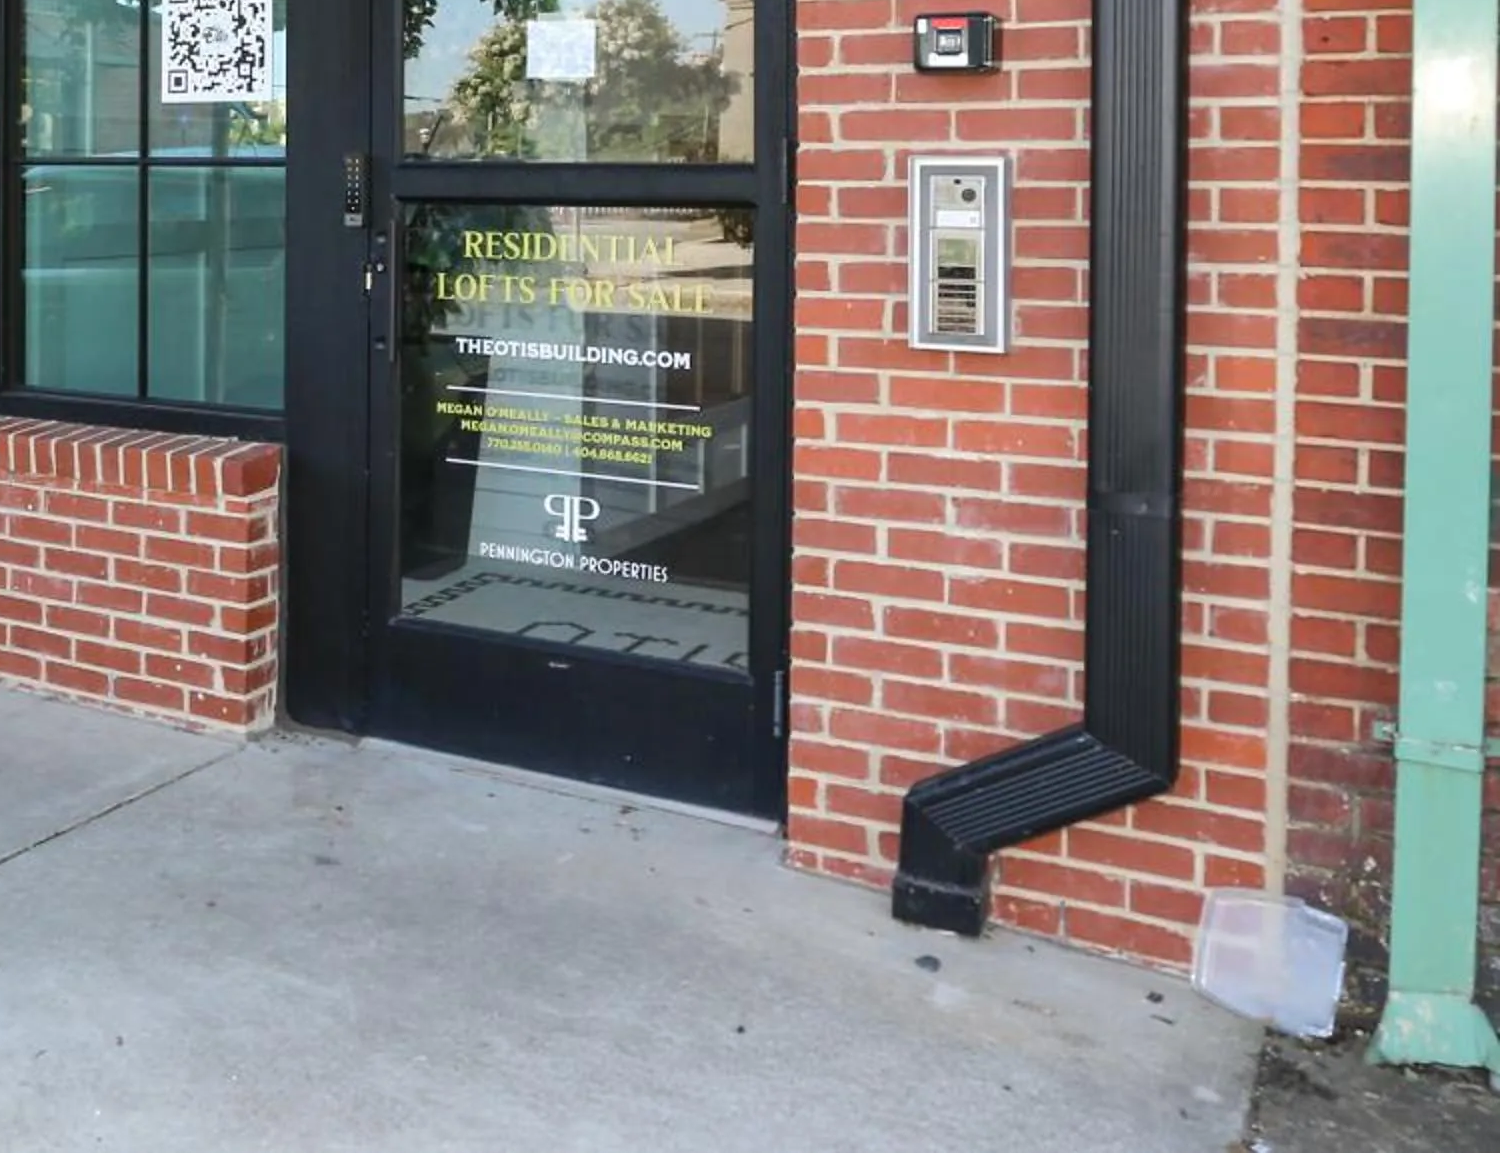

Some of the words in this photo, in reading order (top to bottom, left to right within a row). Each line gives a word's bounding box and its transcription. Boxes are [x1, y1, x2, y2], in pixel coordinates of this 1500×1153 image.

[463, 230, 684, 267] RESIDENTIAL
[436, 272, 536, 304] LOFTS
[550, 278, 615, 311] FOR
[628, 283, 715, 315] SALE
[456, 336, 692, 371] THEOTISBUILDING.COM
[436, 401, 483, 416] MEGAN
[563, 413, 610, 428] SALES
[625, 418, 714, 439] MARKETING
[479, 542, 576, 569] PENNINGTON
[579, 556, 669, 584] PROPERTIES
